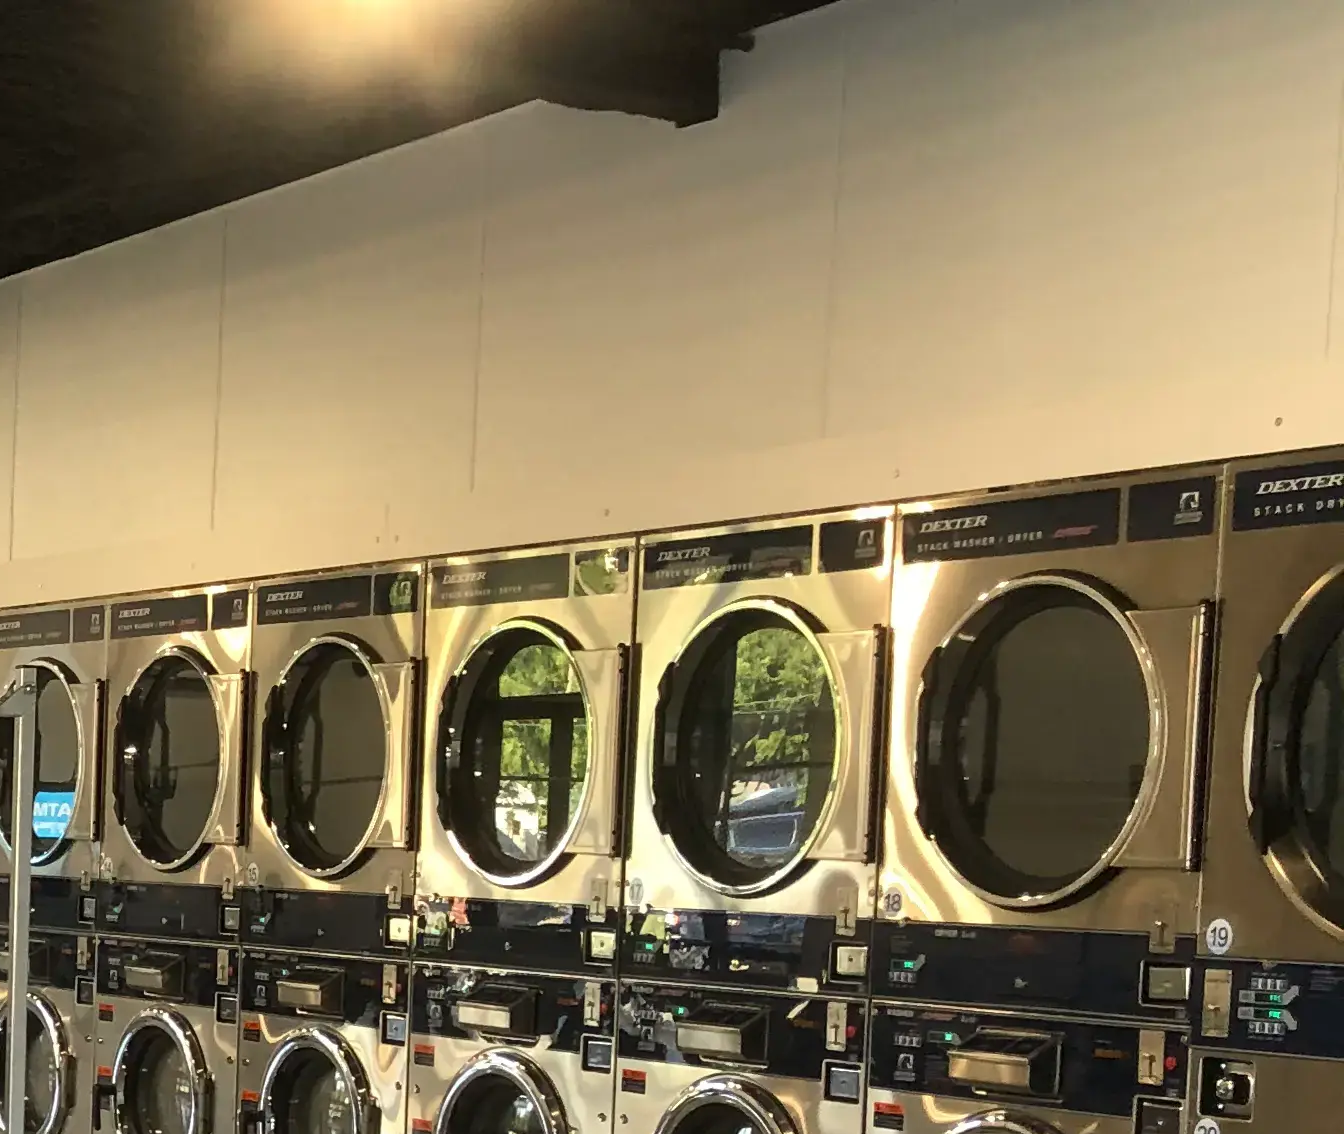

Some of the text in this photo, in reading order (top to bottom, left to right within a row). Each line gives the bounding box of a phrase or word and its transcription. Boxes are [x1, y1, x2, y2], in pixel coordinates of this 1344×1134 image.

[1255, 473, 1344, 496] DEXTER
[1253, 503, 1305, 518] STACK
[919, 515, 988, 533] DEXTER
[917, 541, 949, 553] STACK
[953, 536, 995, 549] WASHER
[657, 546, 711, 562] DEXTER
[266, 590, 304, 603] DEXTER
[118, 607, 151, 619] DEXTER
[885, 893, 902, 912] 18
[1210, 927, 1230, 947] 19
